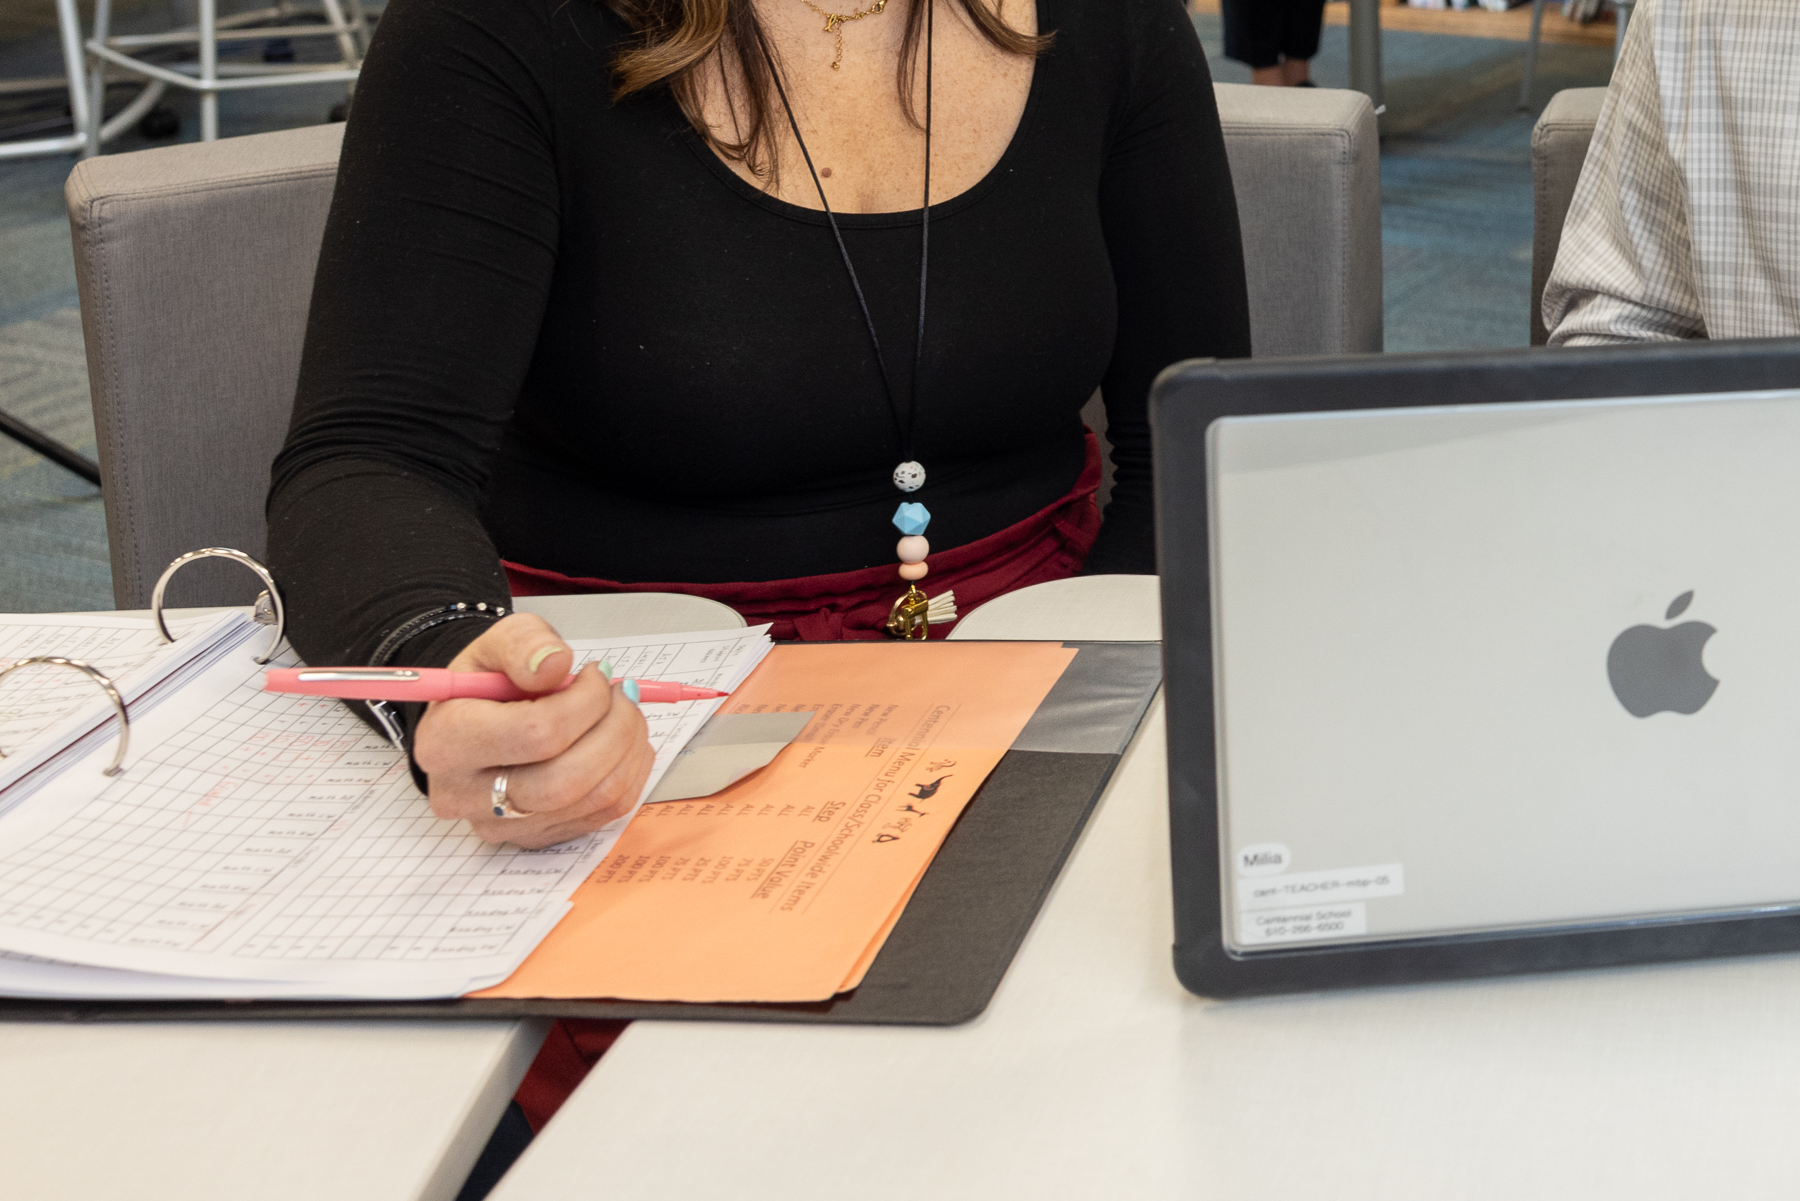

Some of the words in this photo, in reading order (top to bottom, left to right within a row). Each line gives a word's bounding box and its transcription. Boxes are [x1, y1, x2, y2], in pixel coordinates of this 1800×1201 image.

[844, 704, 862, 716] New
[863, 704, 880, 717] New
[880, 704, 899, 718] New
[852, 716, 869, 729] Pen
[906, 705, 951, 751] Centennial
[870, 736, 897, 758] Item
[799, 746, 826, 768] Marker
[884, 750, 916, 778] Menu
[876, 777, 896, 793] for
[656, 804, 675, 816] ALL
[676, 804, 695, 816] ALL
[697, 804, 715, 816] ALL
[717, 803, 735, 816] ALL
[736, 803, 754, 816] ALL
[757, 804, 775, 816] ALL
[777, 804, 796, 816] ALL
[798, 805, 816, 817] ALL
[818, 800, 846, 823] Step
[805, 793, 882, 879] Class/Schoolwide
[609, 854, 631, 870] 200
[674, 857, 691, 867] 75
[695, 857, 712, 867] 25
[757, 856, 775, 868] 50
[781, 840, 816, 869] Point
[630, 855, 651, 871] 100
[652, 855, 672, 870] 100
[713, 856, 735, 870] 100
[737, 857, 754, 868] 75
[596, 869, 616, 884] PTS
[617, 869, 637, 884] PTS
[638, 868, 659, 883] PTS
[661, 866, 682, 881] PTS
[683, 867, 704, 882] PTS
[702, 869, 722, 884] PTS
[724, 867, 744, 882] PTS
[745, 867, 767, 882] PTS
[756, 869, 789, 900] Value
[780, 880, 816, 912] Items
[1256, 912, 1313, 926] Centennial
[1316, 909, 1353, 921] School
